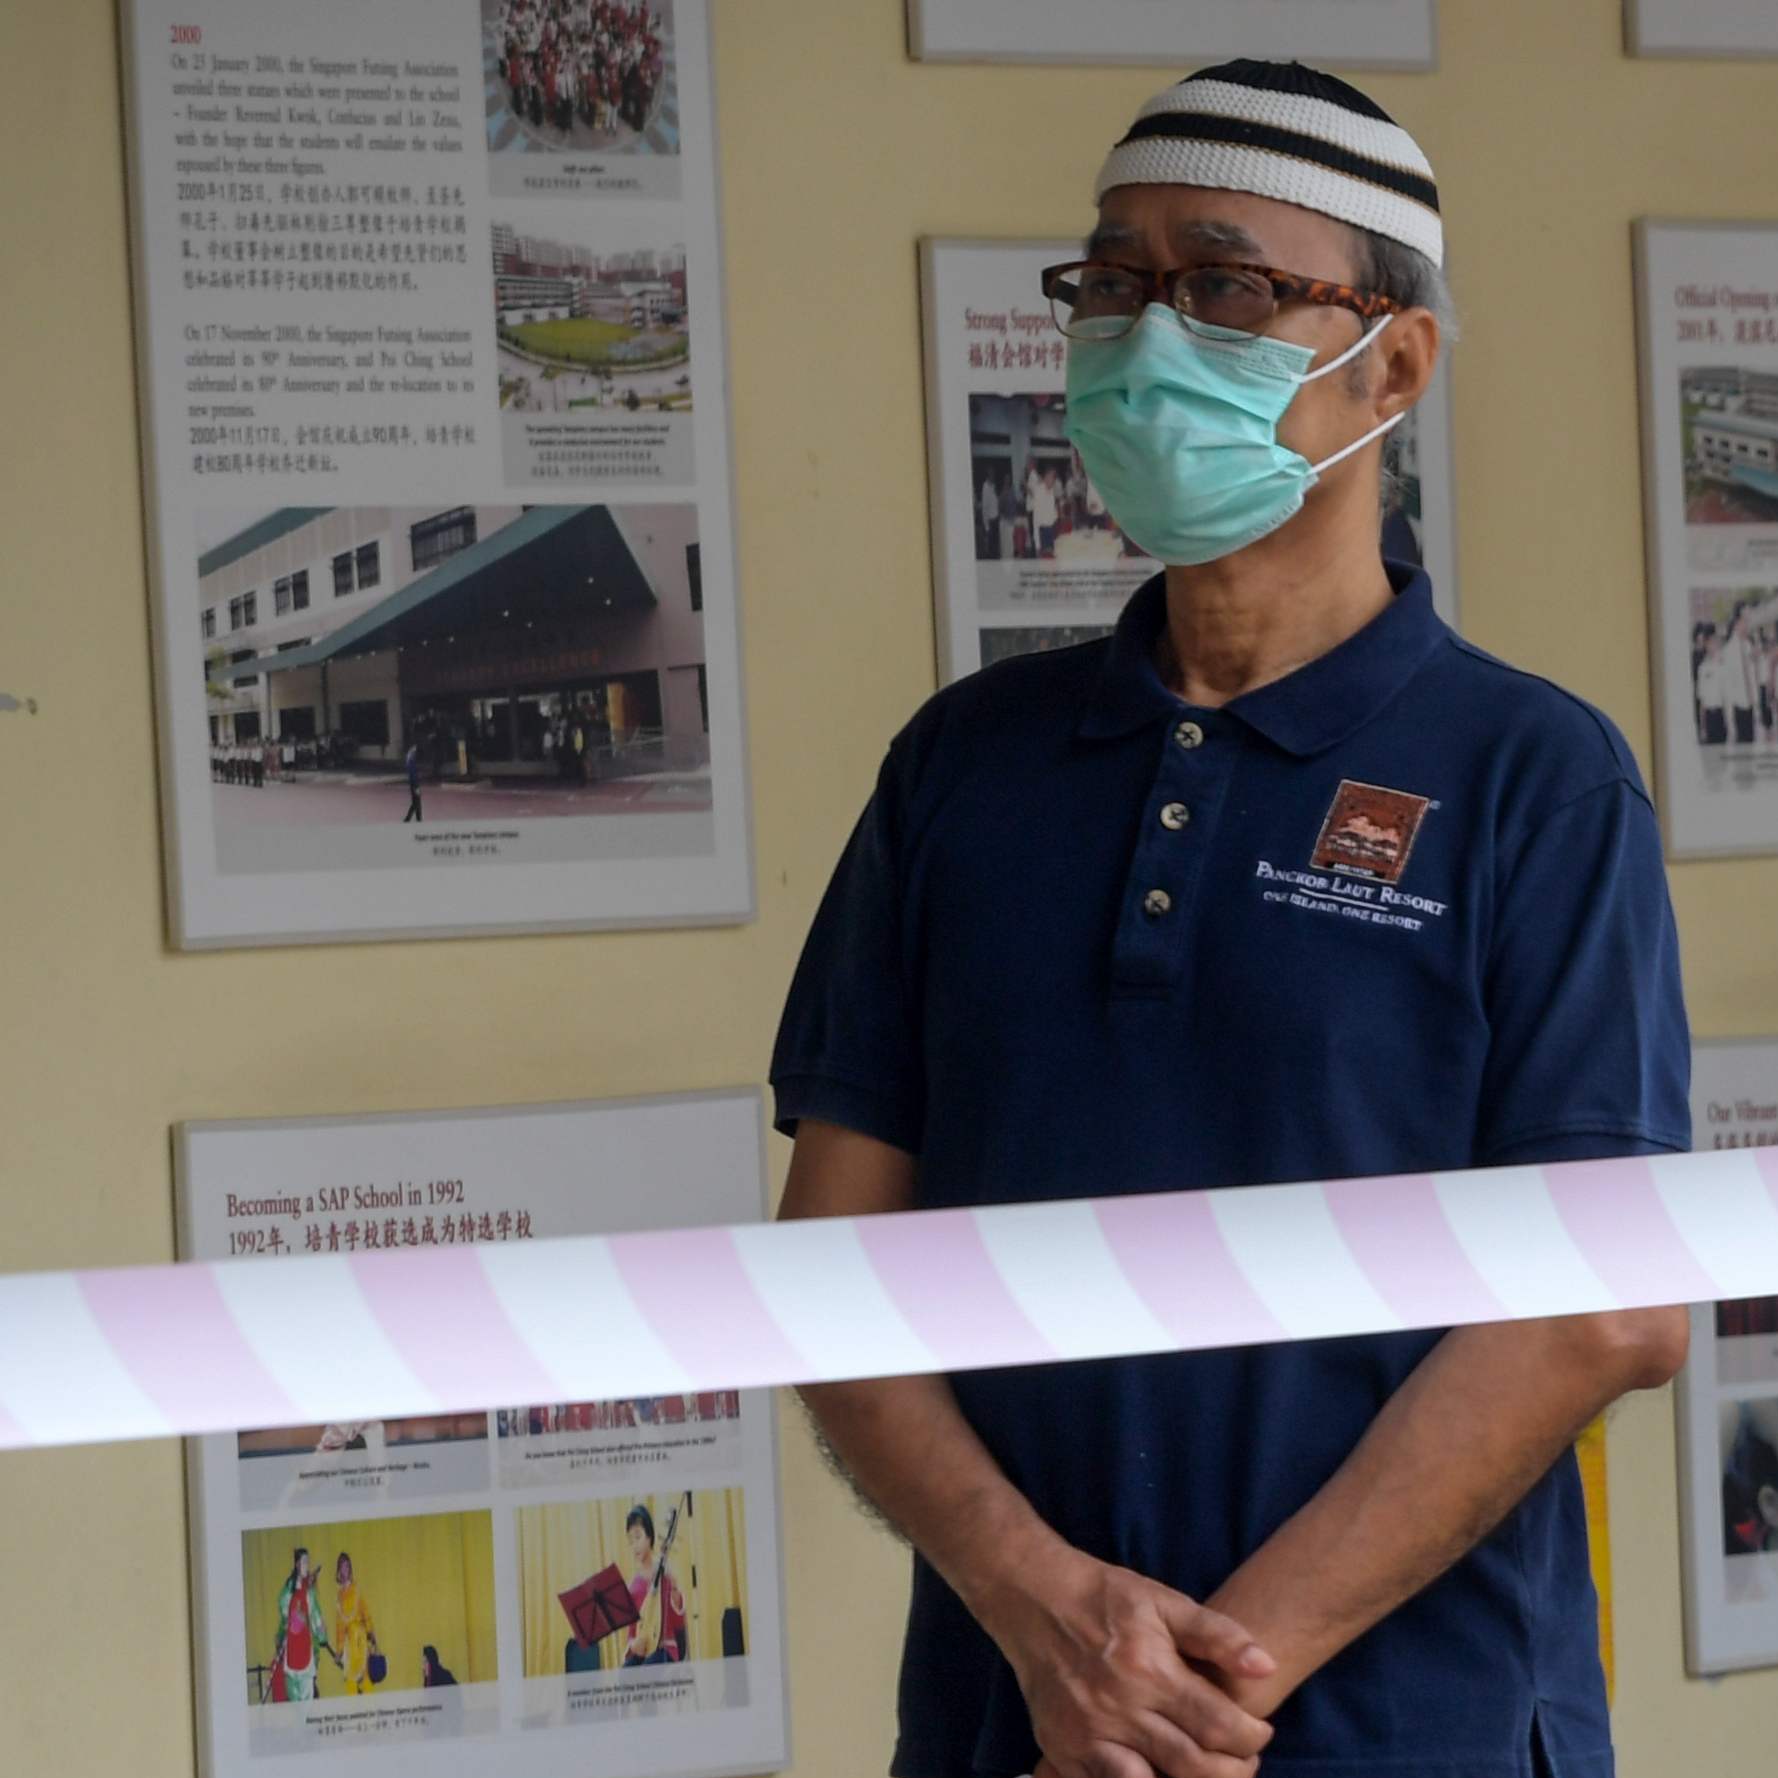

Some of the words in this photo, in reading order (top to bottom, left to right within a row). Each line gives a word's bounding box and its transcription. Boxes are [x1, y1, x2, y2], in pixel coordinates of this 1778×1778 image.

[170, 25, 201, 44] 2000
[309, 56, 357, 77] Singapore
[404, 60, 458, 77] Association
[1674, 284, 1716, 308] Official
[1720, 284, 1770, 313] Opening
[965, 307, 1007, 335] Strong
[326, 325, 373, 346] Singapore
[417, 327, 471, 342] Association
[1332, 877, 1376, 900] LAUT
[1380, 886, 1448, 916] RESORT
[1342, 906, 1370, 921] ONE
[1372, 912, 1423, 931] RESORT
[1707, 1101, 1731, 1122] Our
[1735, 1099, 1777, 1121] Vibrant
[226, 1193, 302, 1220] Becoming
[306, 1196, 313, 1206] a
[319, 1188, 349, 1212] SAP
[354, 1183, 403, 1209] School
[409, 1189, 422, 1206] in
[428, 1180, 465, 1205] 1992
